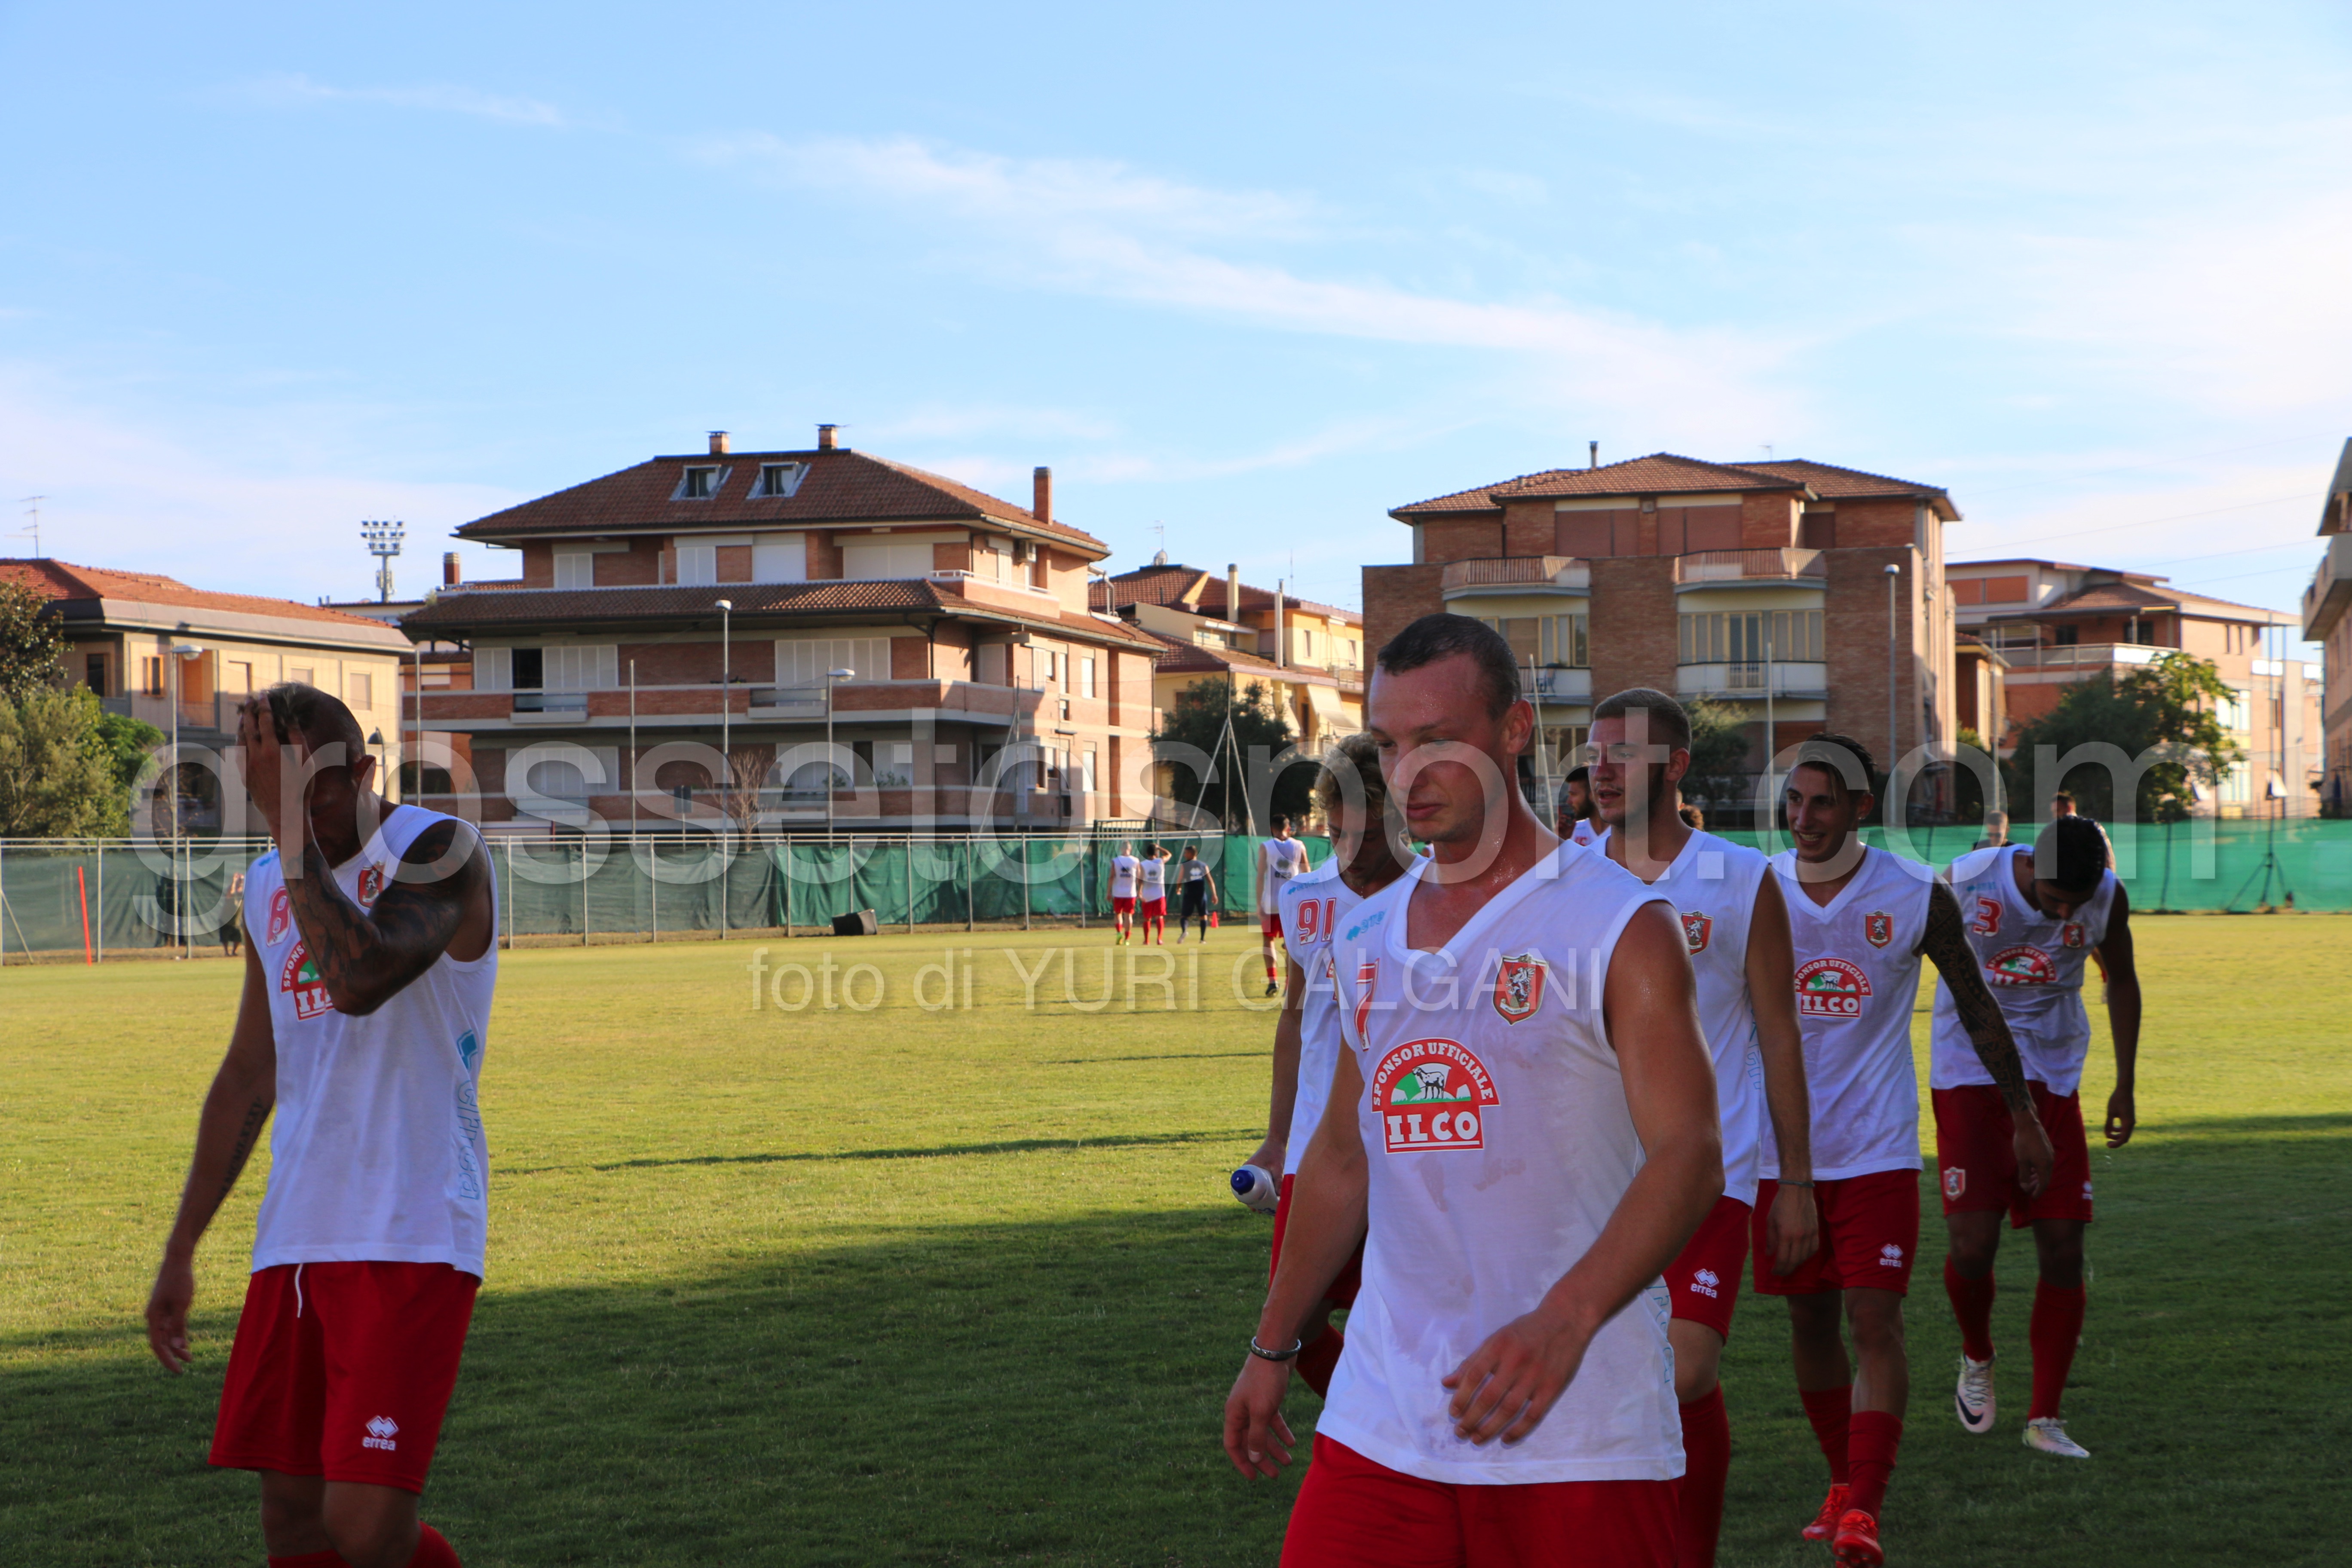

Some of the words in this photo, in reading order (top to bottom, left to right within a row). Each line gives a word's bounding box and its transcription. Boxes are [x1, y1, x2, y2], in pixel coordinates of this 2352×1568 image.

[266, 886, 291, 947] 8
[1297, 897, 1336, 945] 91
[1972, 897, 2003, 937] 3
[1795, 960, 1827, 989] SPONSOR
[1828, 960, 1869, 993] UFFICIALE
[1354, 958, 1380, 1051] 7
[1802, 995, 1859, 1013] ILCO
[1374, 1044, 1425, 1106] SPONSOR
[1427, 1042, 1493, 1099] UFFICIALE
[1387, 1111, 1479, 1143] ILCO
[1690, 1283, 1717, 1298] errea
[362, 1436, 396, 1451] errea
